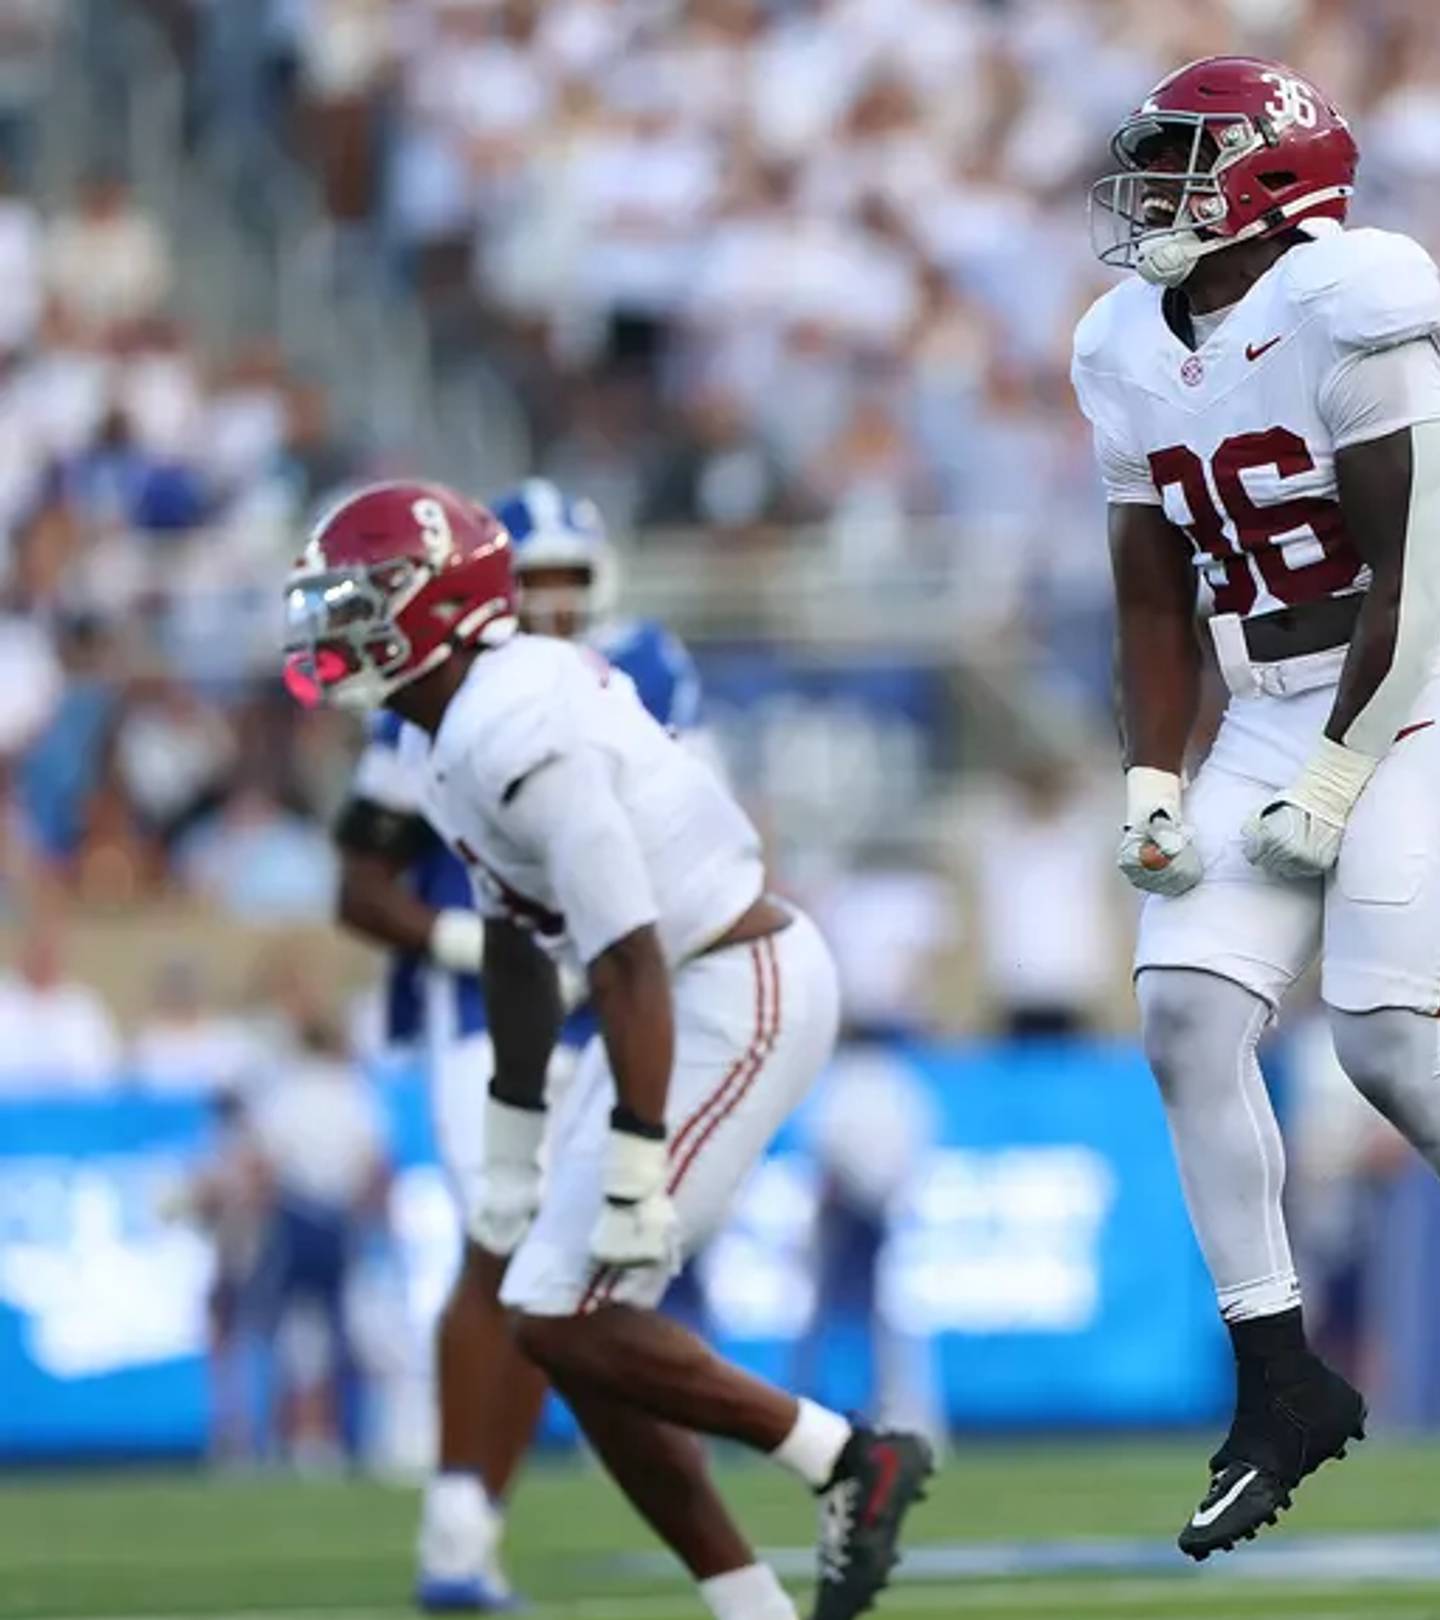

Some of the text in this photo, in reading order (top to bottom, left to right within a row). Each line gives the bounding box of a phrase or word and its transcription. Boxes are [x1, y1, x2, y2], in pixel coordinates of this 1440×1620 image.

[1260, 72, 1317, 129] 36
[411, 498, 452, 556] 9
[1147, 425, 1362, 615] 36
